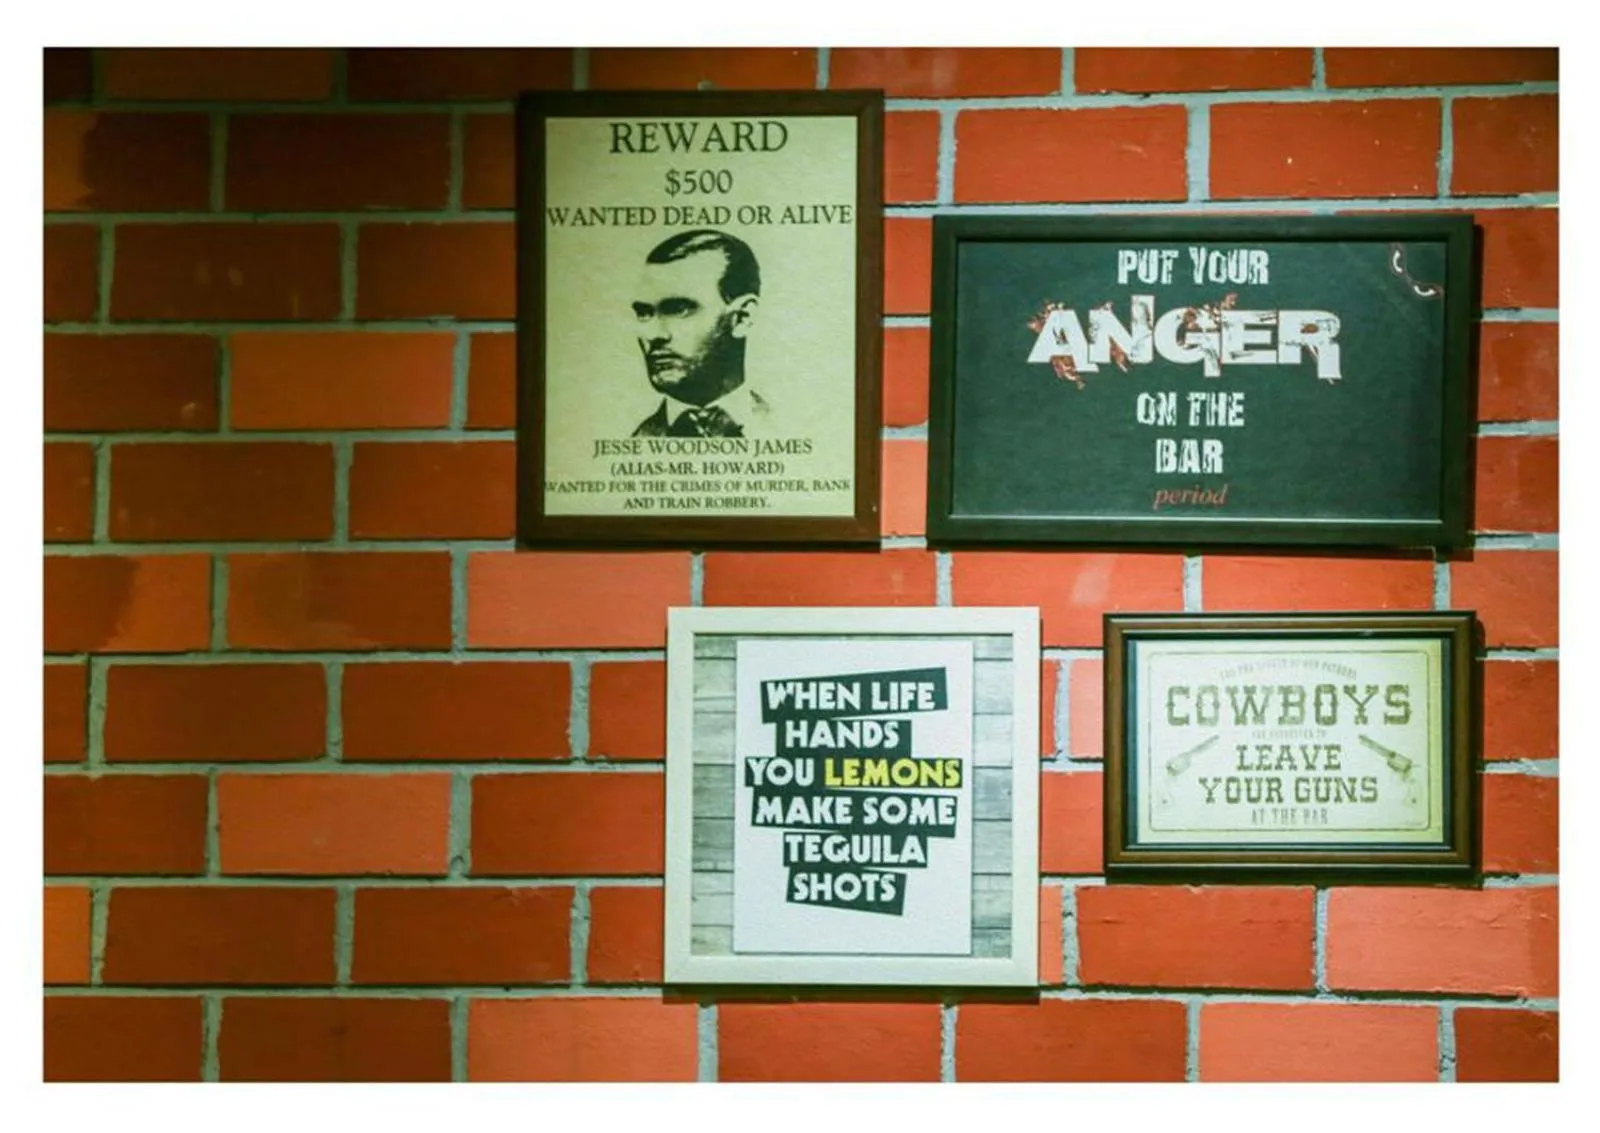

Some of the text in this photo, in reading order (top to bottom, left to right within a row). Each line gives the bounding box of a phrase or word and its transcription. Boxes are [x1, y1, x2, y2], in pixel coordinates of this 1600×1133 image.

[609, 120, 789, 154] REWARD
[664, 168, 734, 198] $500
[547, 204, 854, 228] WANTED DEAD OR ALIVE
[1117, 246, 1270, 285] PUT YOUR
[1027, 295, 1343, 380] ANGER
[1136, 391, 1245, 427] ON THE
[592, 438, 813, 459] JESSE WOODSON JAMES
[1155, 438, 1223, 474] BAR
[610, 460, 785, 477] (ALIAS-MR. HOWARD)
[545, 479, 606, 493] WANTED
[608, 480, 636, 493] FOR
[640, 480, 667, 493] THE
[670, 480, 722, 493] CRIMES
[724, 480, 743, 493] OF
[812, 478, 851, 491] BANK
[1152, 483, 1228, 510] period
[623, 497, 656, 510] AND
[658, 497, 701, 510] TRAIN
[766, 681, 936, 711] WHEN LIFE
[1166, 683, 1413, 727] COWBOYS
[785, 720, 899, 749] HANDS
[746, 757, 961, 787] YOU LEMONS
[1236, 744, 1342, 771] LEAVE
[1199, 776, 1379, 804] YOUR GUNS
[755, 796, 955, 826] MAKE SOME
[785, 834, 927, 864] TEQUILA
[793, 873, 897, 902] SHOTS
